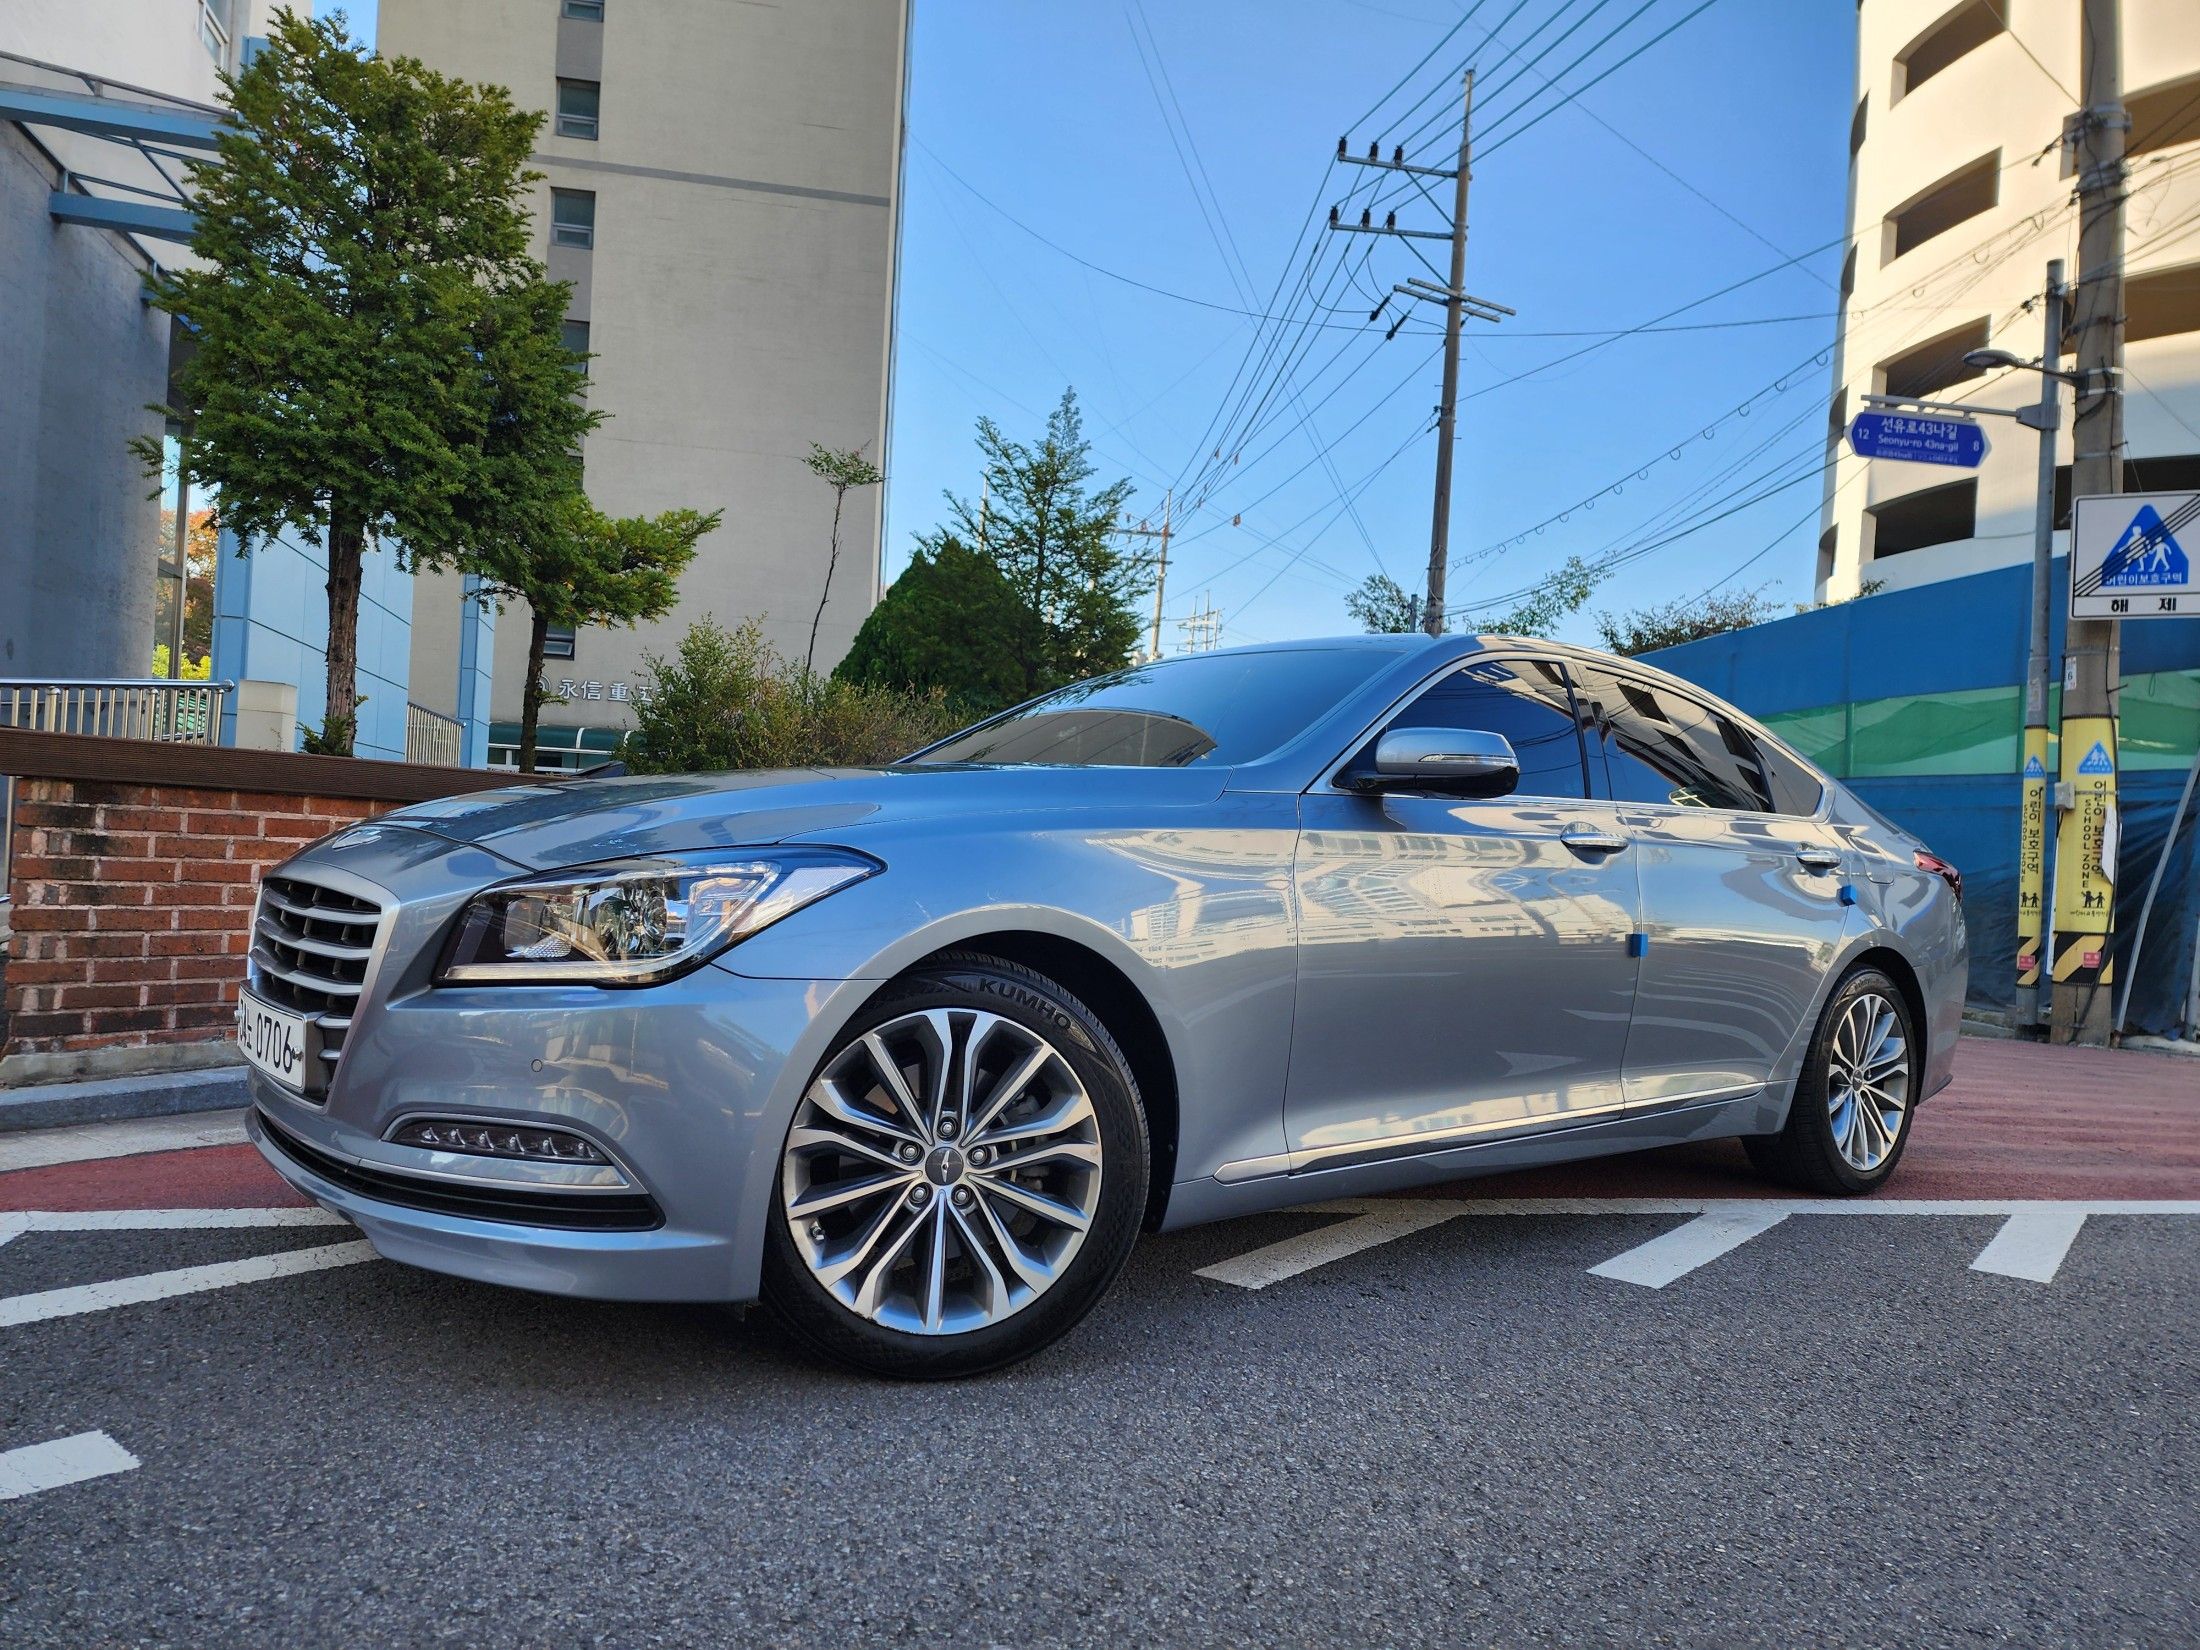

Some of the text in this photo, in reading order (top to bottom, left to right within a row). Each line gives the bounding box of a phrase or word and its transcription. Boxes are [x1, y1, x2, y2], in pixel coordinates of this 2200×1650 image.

[1858, 428, 1870, 440] 12
[1881, 417, 1958, 441] 선유로43나길
[1878, 435, 1959, 453] Seonyu-ro 43na-gil
[1972, 441, 1980, 452] 8
[2106, 572, 2183, 587] 어린이보호구역
[558, 679, 674, 703] 永信重工
[2029, 787, 2043, 823] 어린이
[2027, 829, 2040, 874] 보호구역
[2082, 799, 2092, 888] SCHOOL ZONE
[979, 977, 1072, 1030] KUMHO
[256, 1012, 293, 1074] 0706
